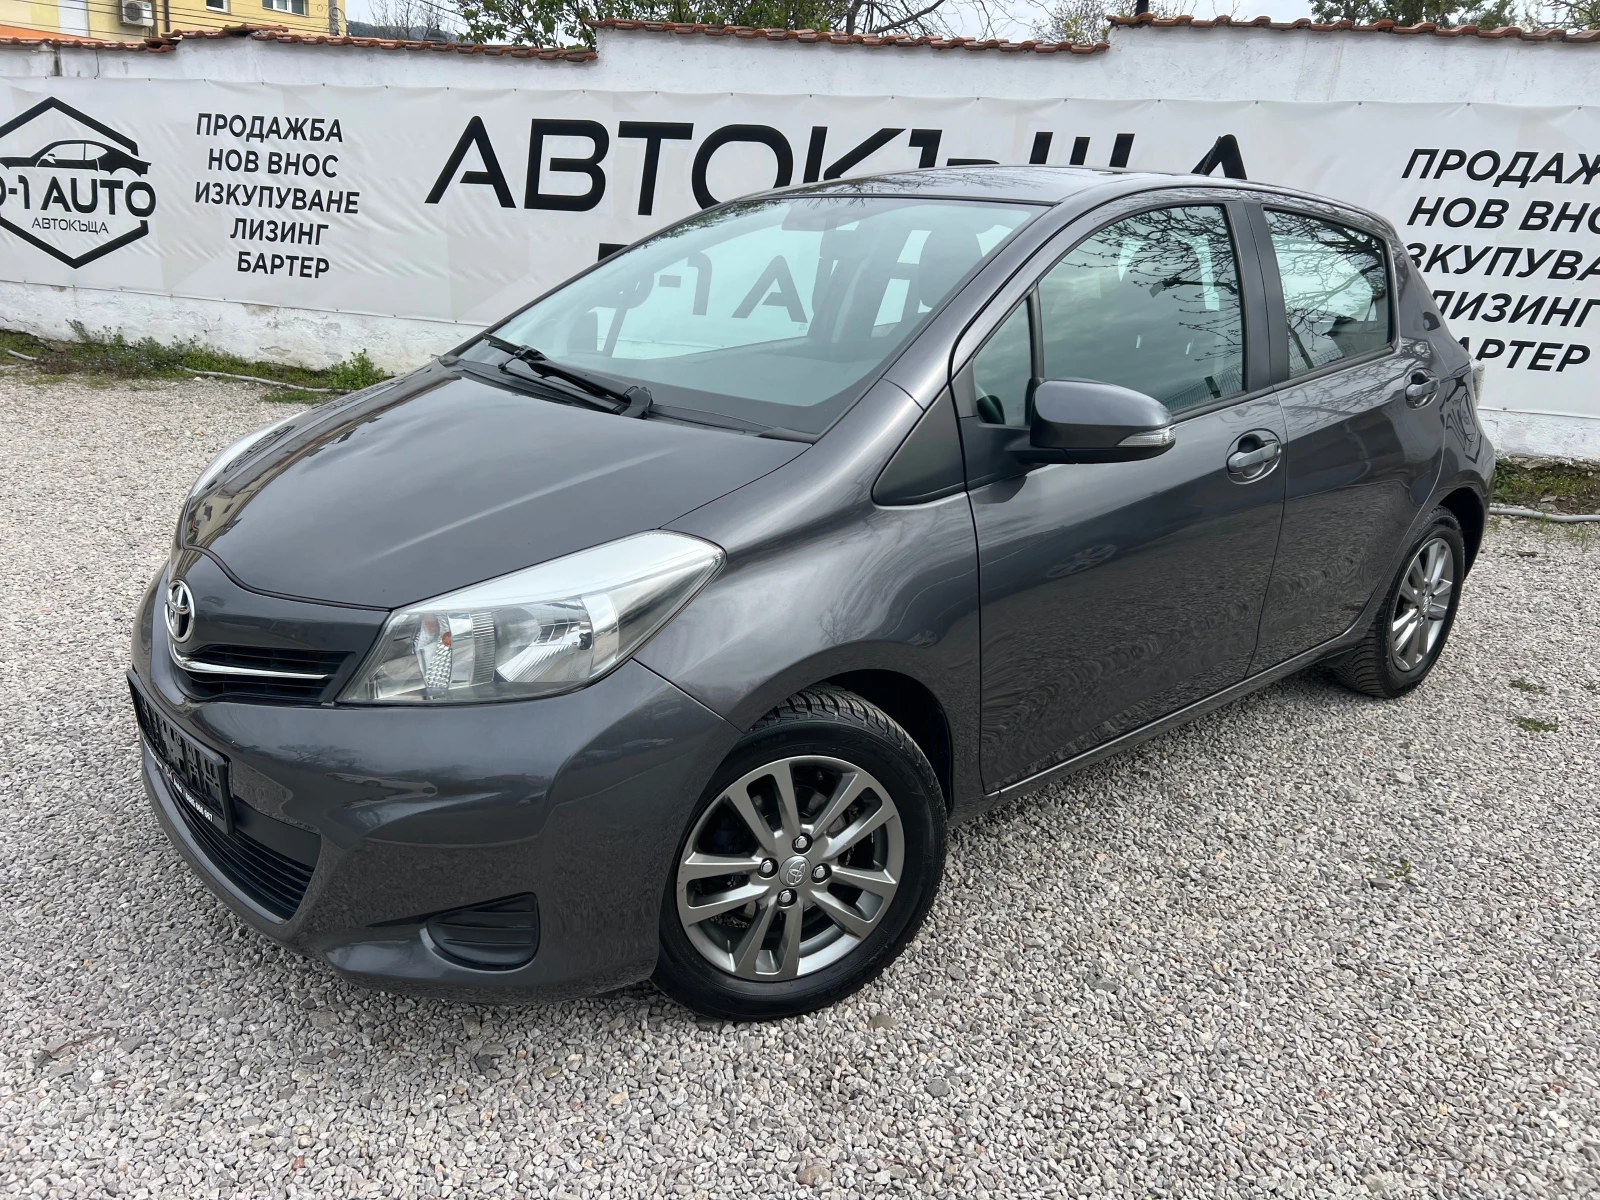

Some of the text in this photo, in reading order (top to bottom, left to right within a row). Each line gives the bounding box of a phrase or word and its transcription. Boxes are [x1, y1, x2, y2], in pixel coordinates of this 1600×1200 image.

[196, 112, 343, 143] ПРОДАЖБА
[208, 148, 339, 178] НОВ ВНОС
[0, 174, 157, 217] -1 AUTO
[195, 181, 360, 214] ИЗКУПУВАНЕ
[32, 217, 109, 234] АВТОКЪЩА
[1406, 196, 1510, 229] НОВ
[230, 217, 329, 246] ЛИЗИНГ
[237, 250, 330, 279] БАРТЕР
